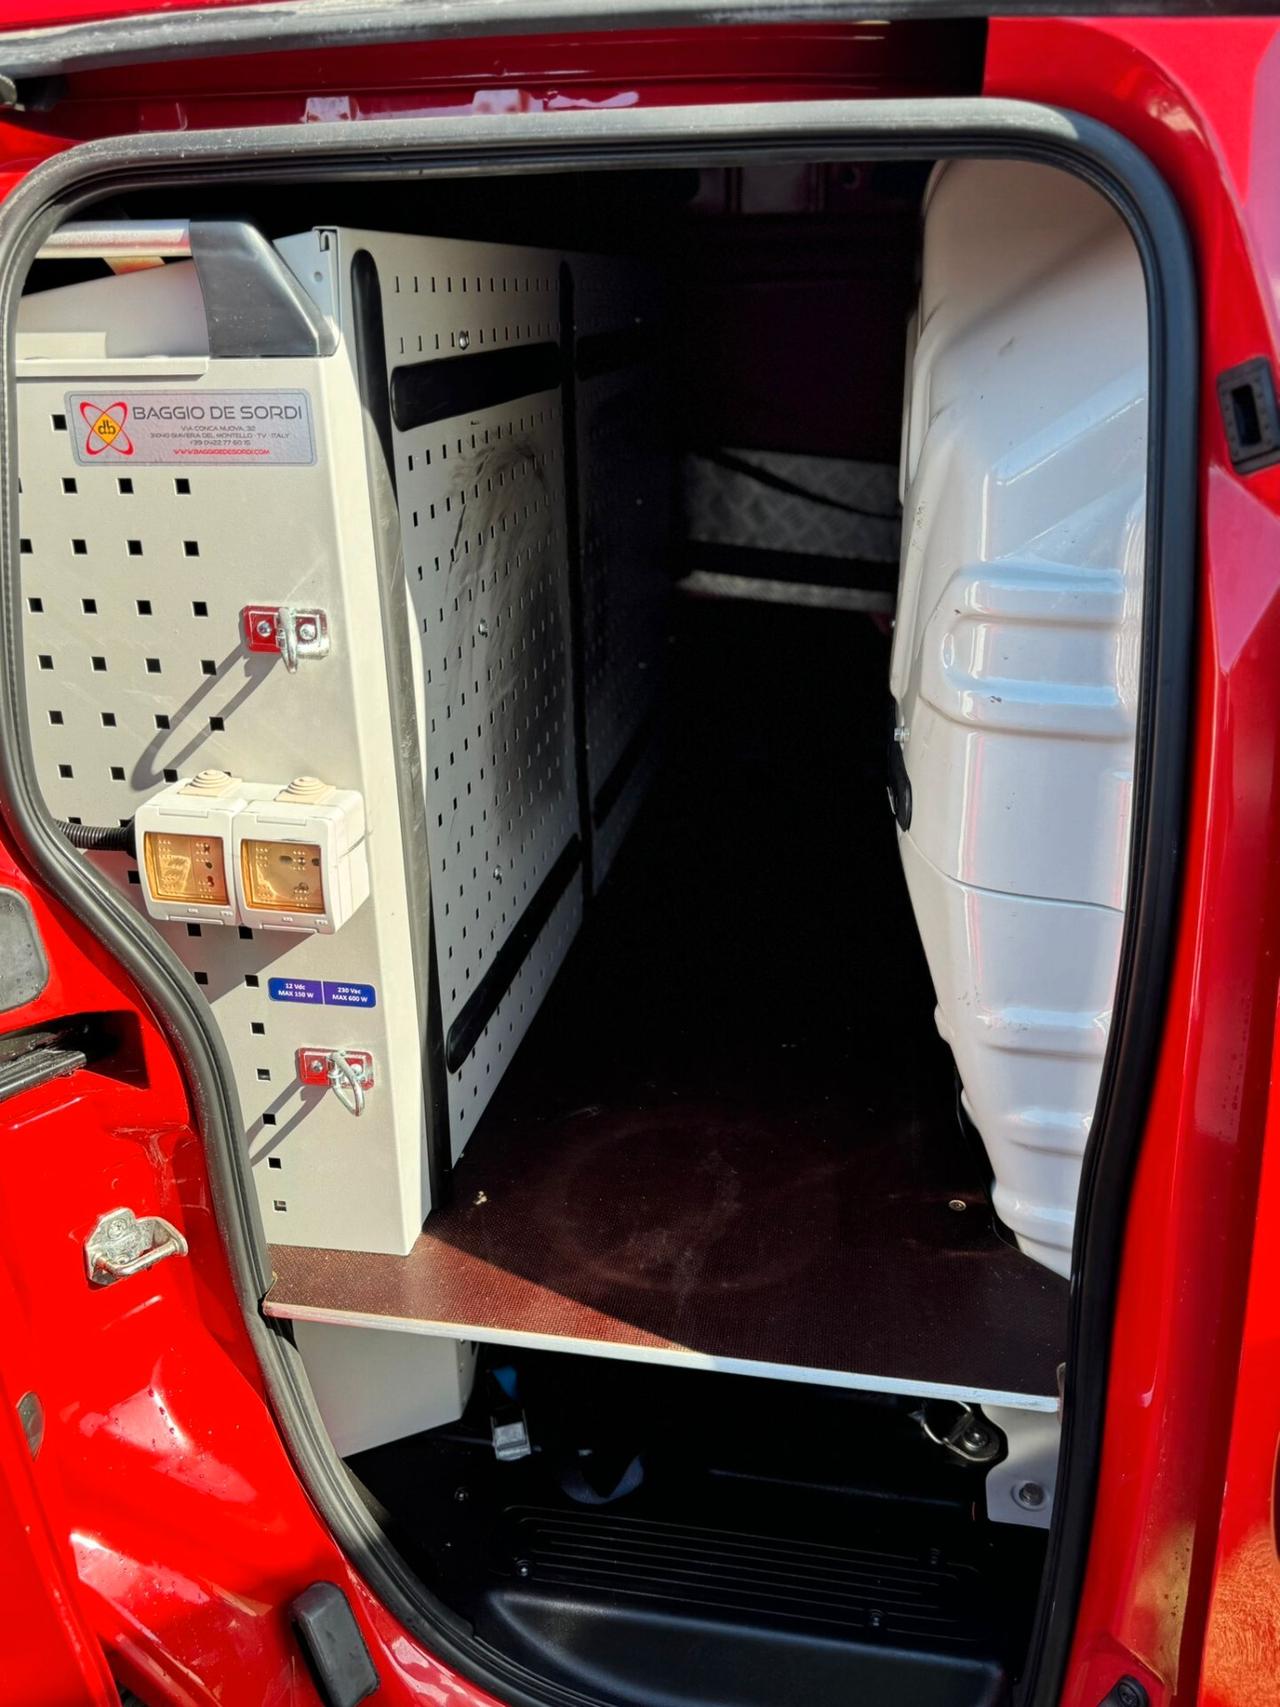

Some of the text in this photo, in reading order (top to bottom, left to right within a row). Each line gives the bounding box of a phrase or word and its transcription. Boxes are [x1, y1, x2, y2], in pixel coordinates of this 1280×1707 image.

[132, 405, 302, 420] BAGGIO DE SORDI
